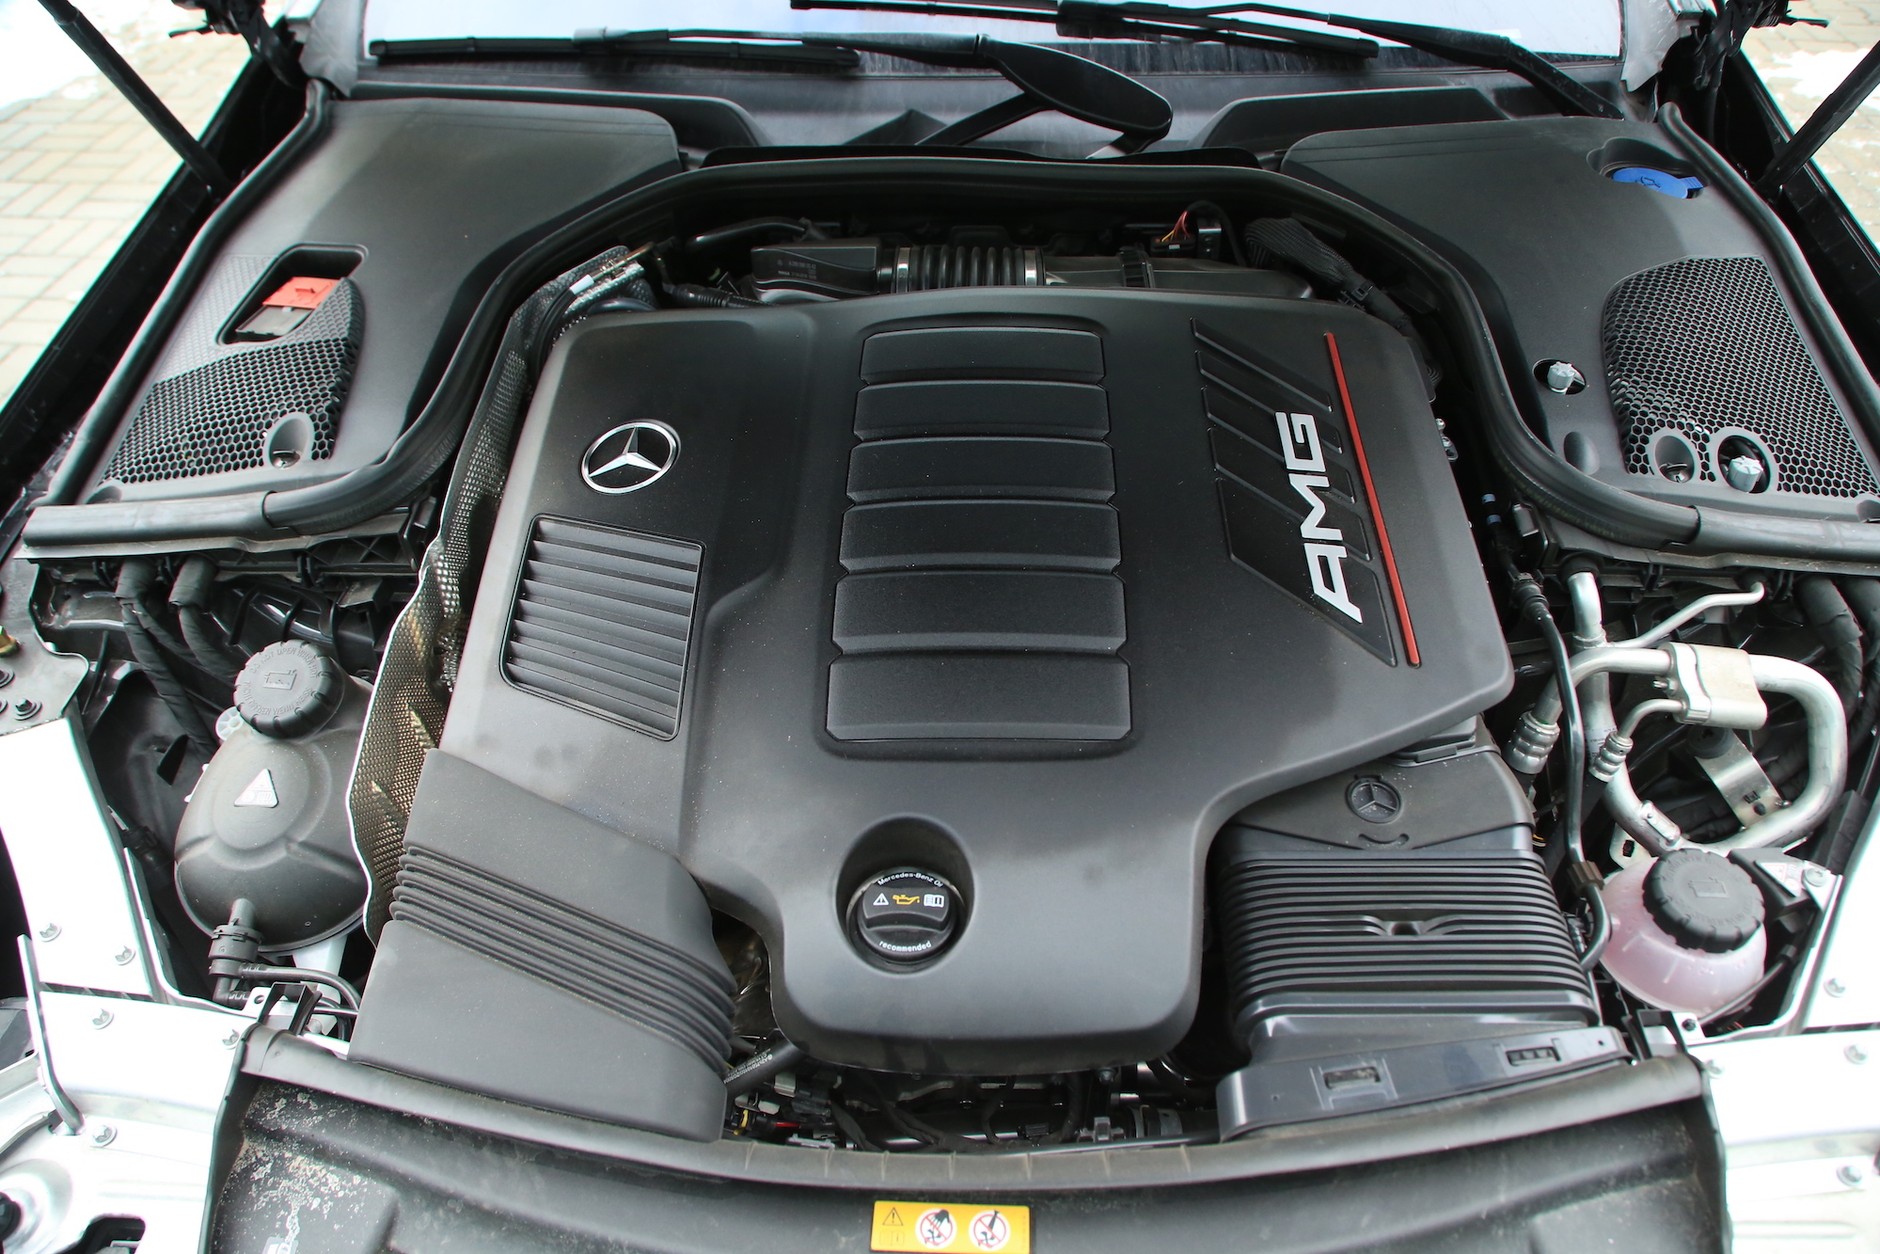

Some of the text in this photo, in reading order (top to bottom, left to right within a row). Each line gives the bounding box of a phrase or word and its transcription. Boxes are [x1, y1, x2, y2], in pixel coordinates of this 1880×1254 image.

[1275, 412, 1363, 624] AMG
[877, 872, 935, 886] Mercedes-Benz
[879, 940, 932, 952] recommended
